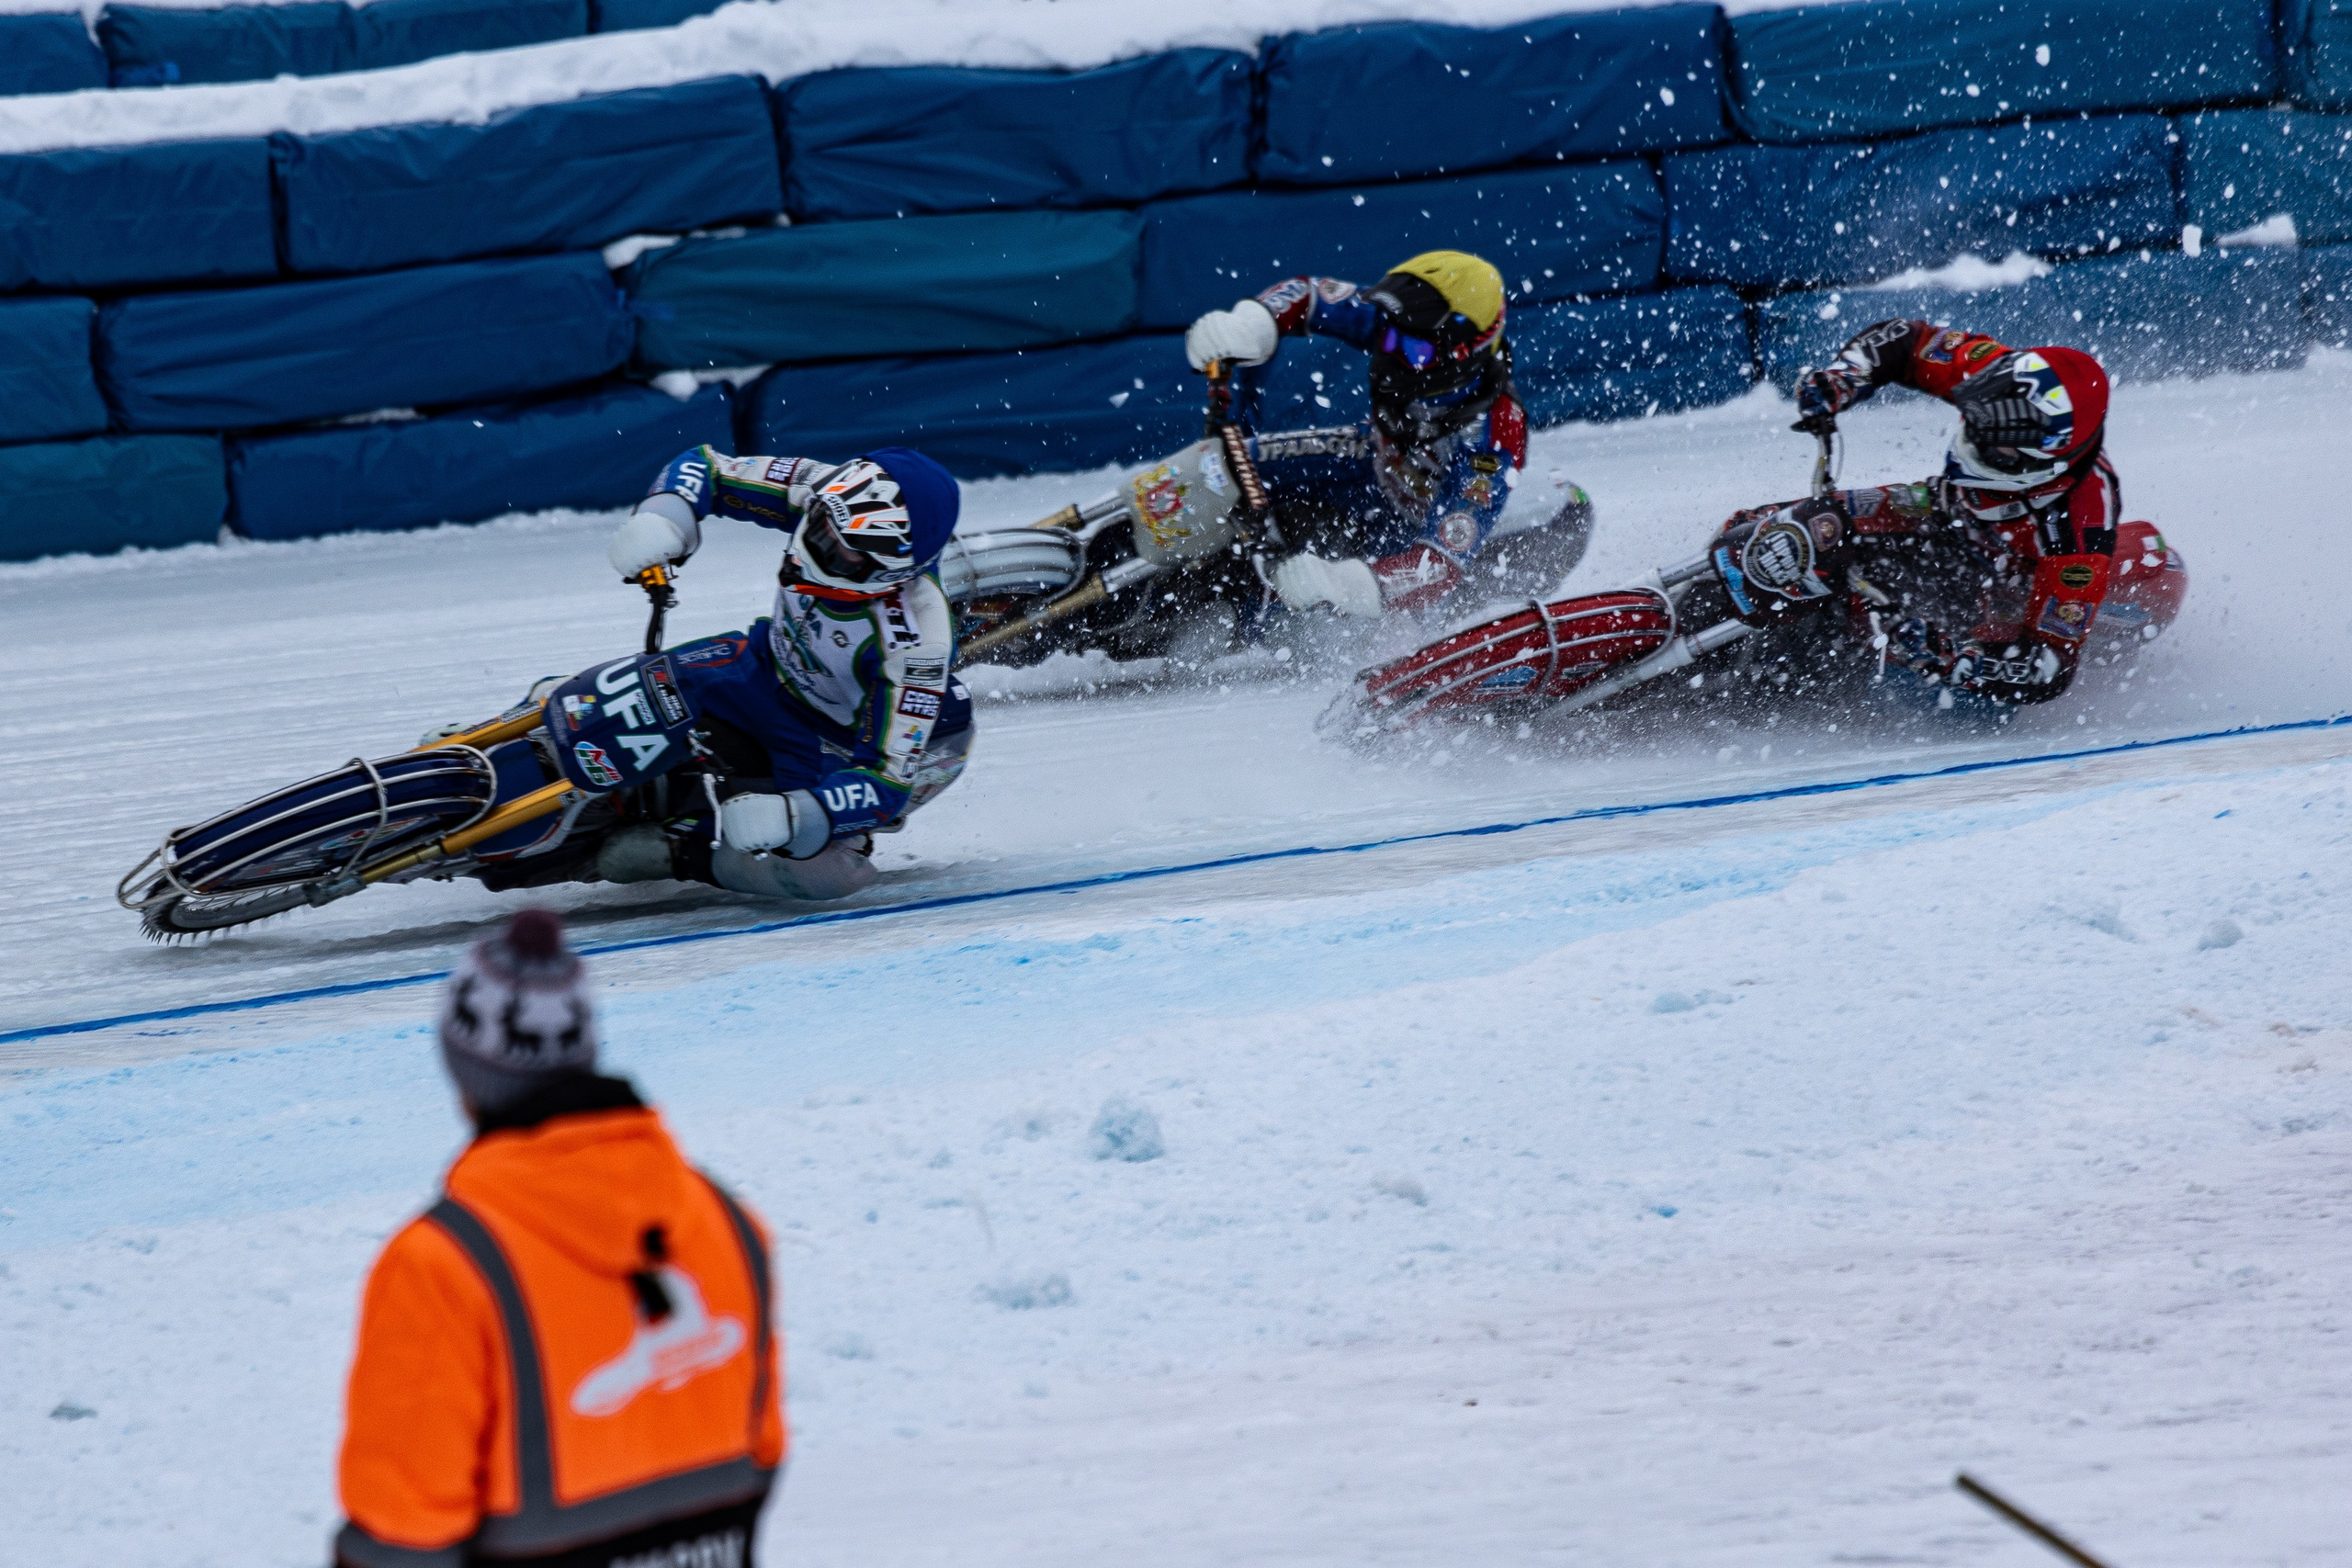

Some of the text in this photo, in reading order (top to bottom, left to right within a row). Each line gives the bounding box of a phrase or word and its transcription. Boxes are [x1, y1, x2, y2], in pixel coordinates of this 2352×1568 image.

[673, 462, 707, 503] UFA
[826, 494, 848, 525] SHOEI
[595, 657, 671, 772] UFA
[822, 782, 880, 812] UFA
